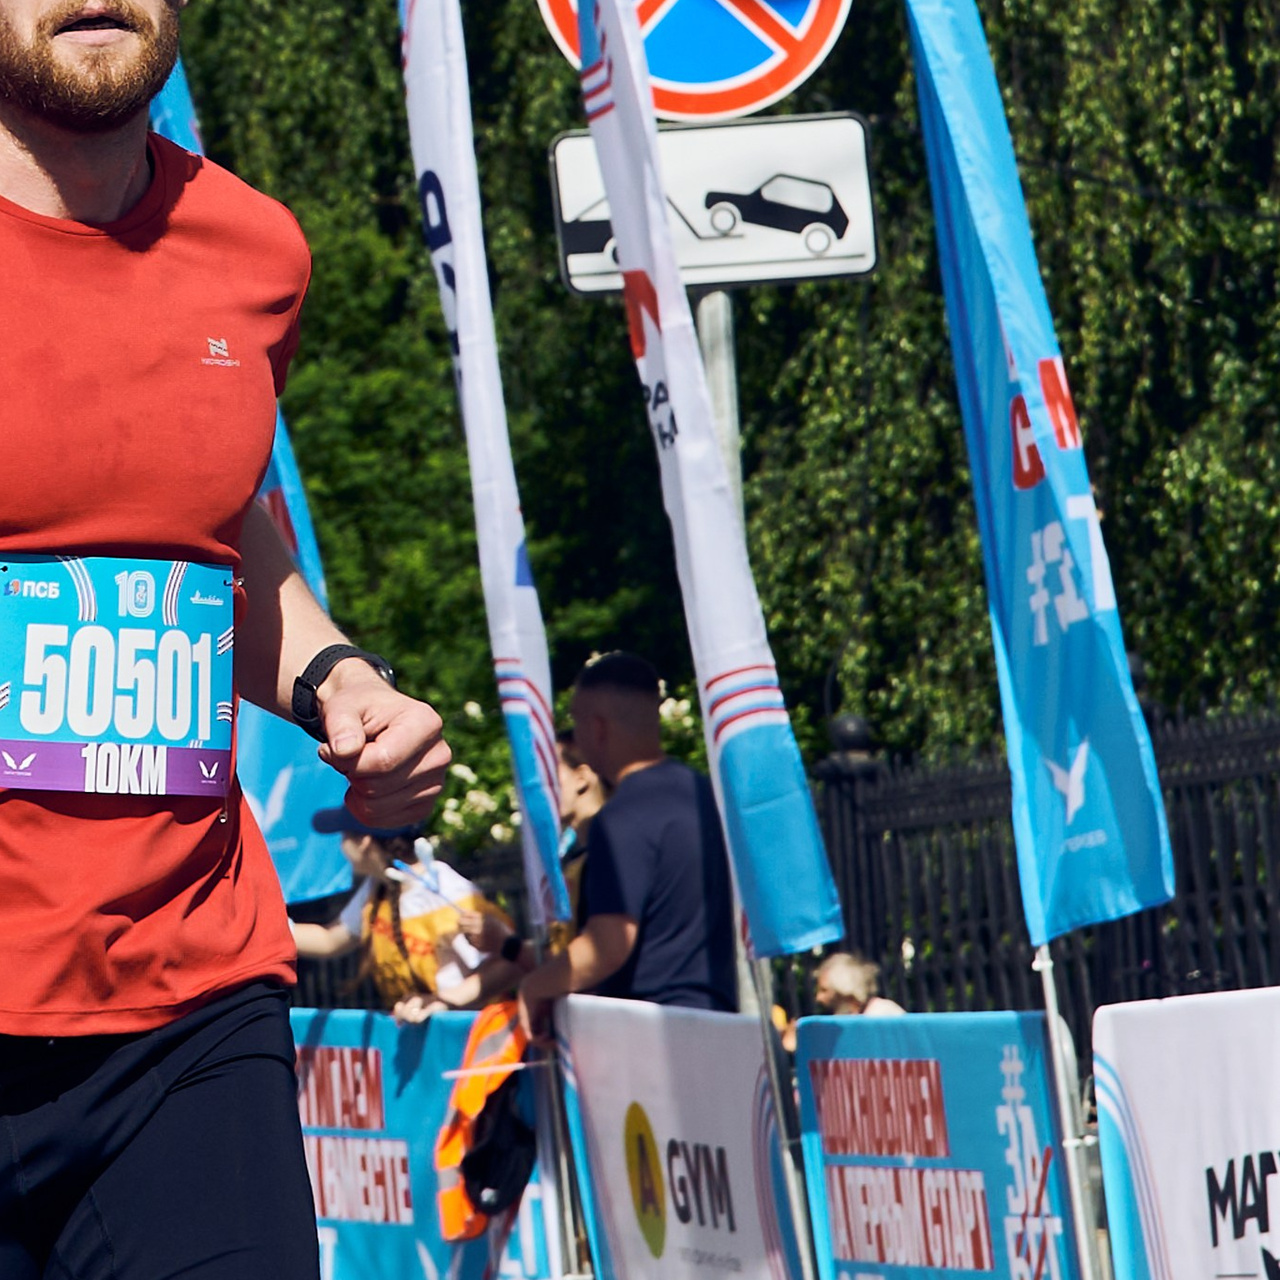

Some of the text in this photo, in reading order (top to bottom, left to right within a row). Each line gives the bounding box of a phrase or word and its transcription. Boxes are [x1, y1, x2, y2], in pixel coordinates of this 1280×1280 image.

[22, 580, 60, 599] ПСБ
[114, 570, 156, 617] 10
[20, 623, 211, 741] 50501
[667, 1138, 737, 1233] GYM
[921, 1169, 995, 1271] СТАРТ
